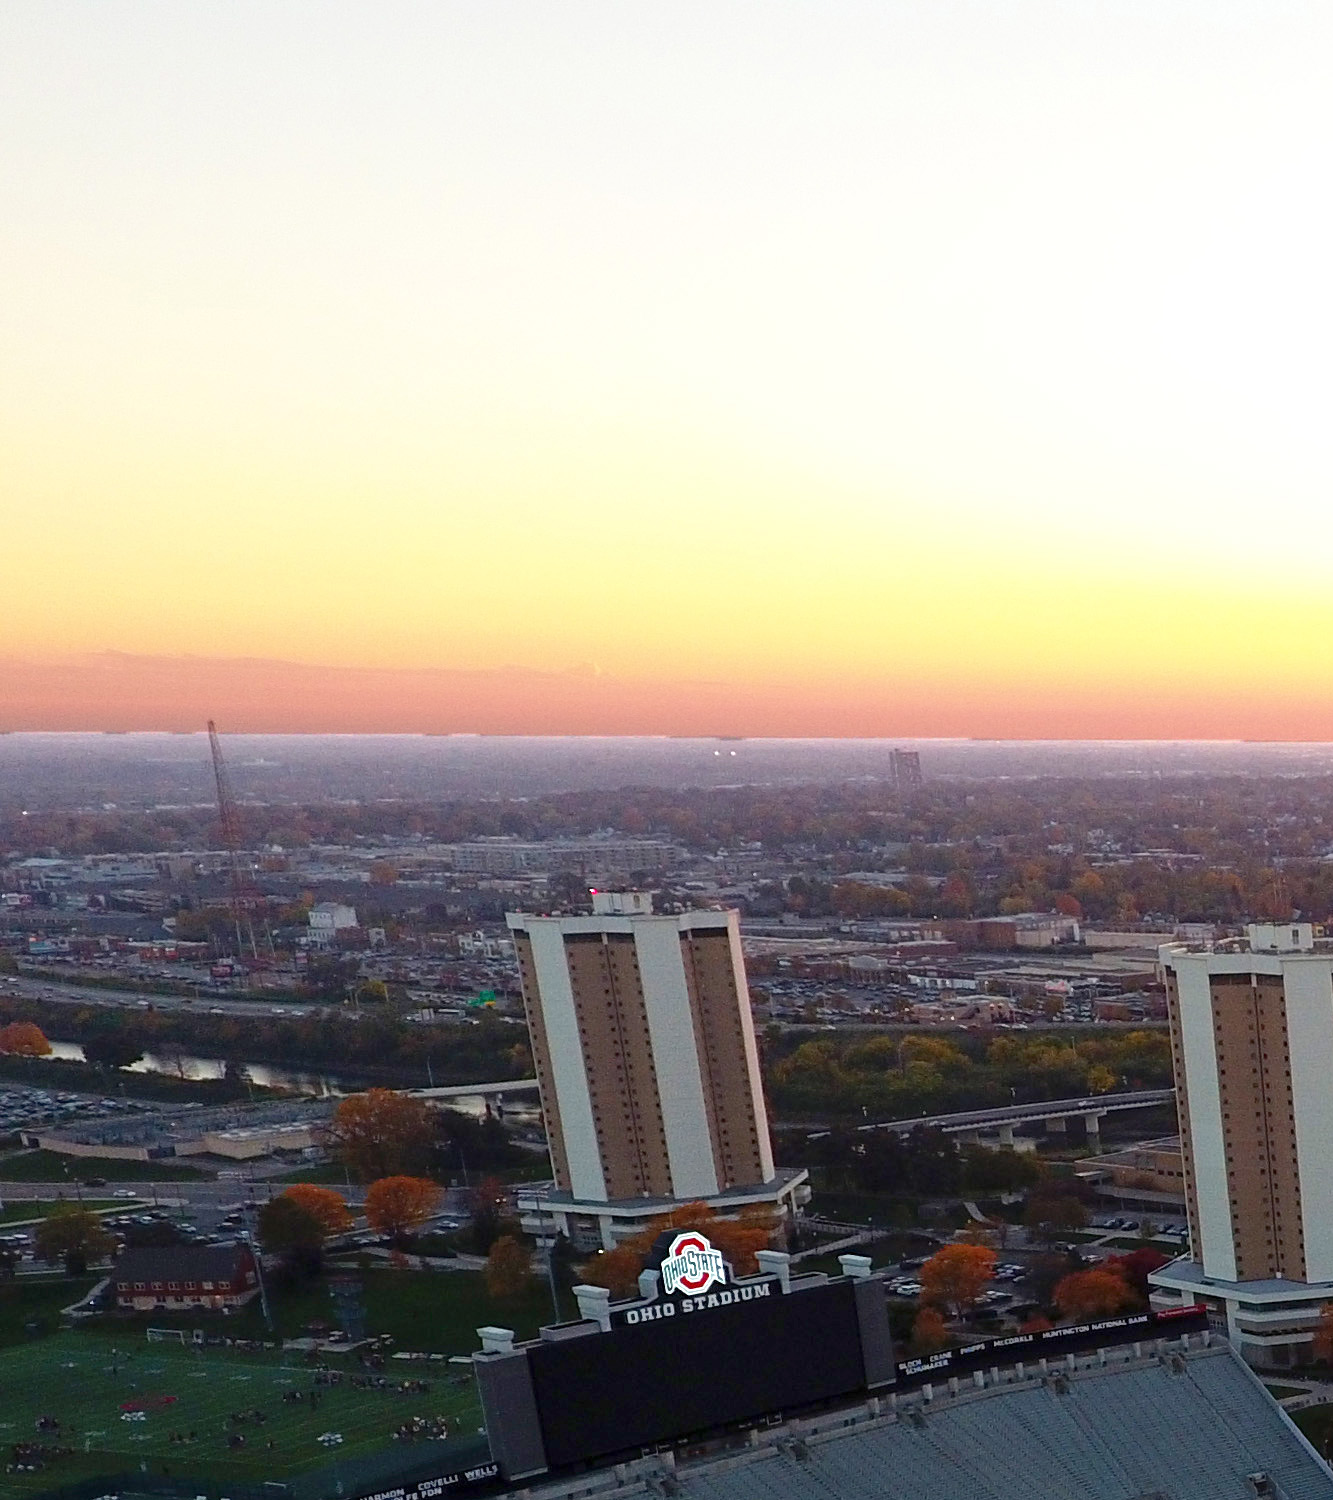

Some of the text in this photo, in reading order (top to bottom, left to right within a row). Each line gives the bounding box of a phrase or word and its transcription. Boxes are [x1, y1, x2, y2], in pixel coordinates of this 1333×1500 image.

[626, 1283, 771, 1325] OHIO STADIUM
[1091, 1318, 1128, 1331] NATIONAL
[417, 1473, 459, 1491] COVELLI
